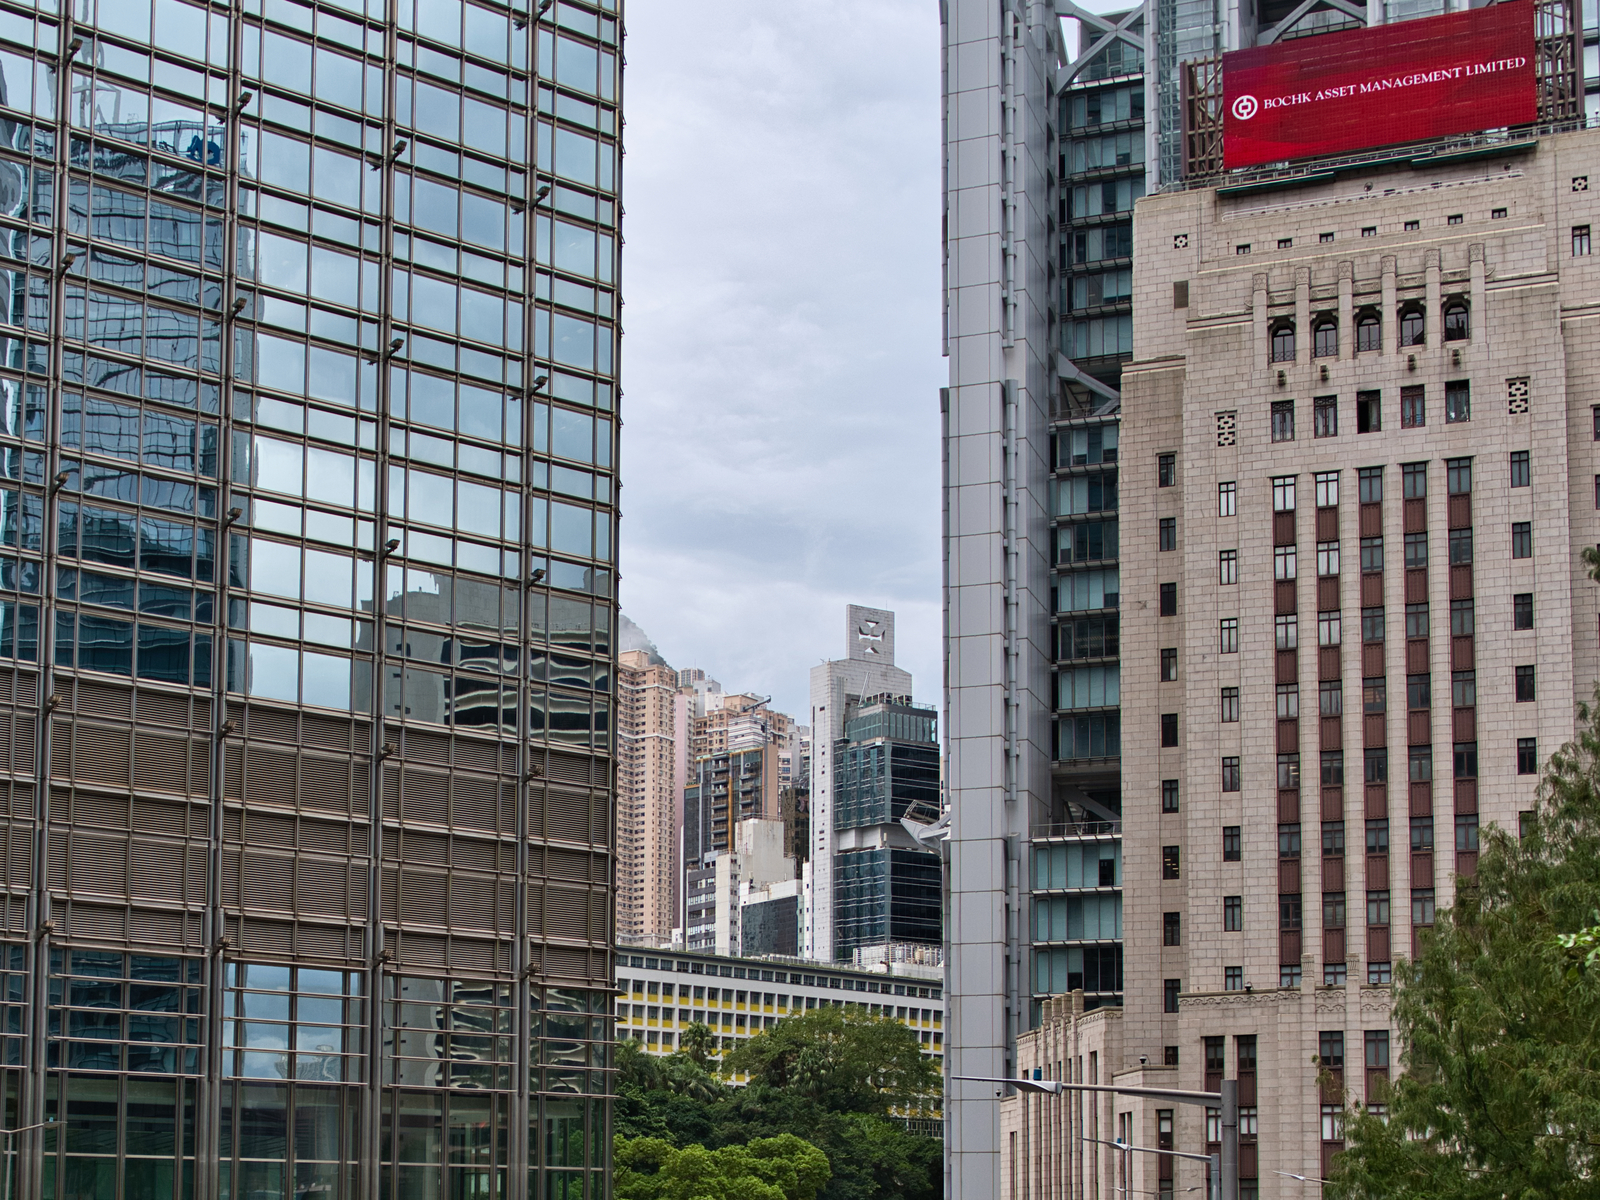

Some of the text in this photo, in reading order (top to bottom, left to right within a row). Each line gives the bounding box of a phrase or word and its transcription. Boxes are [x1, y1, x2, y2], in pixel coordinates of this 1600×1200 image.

[1264, 57, 1526, 109] BOCHK ASSET MANAGEMENT LIMITED
